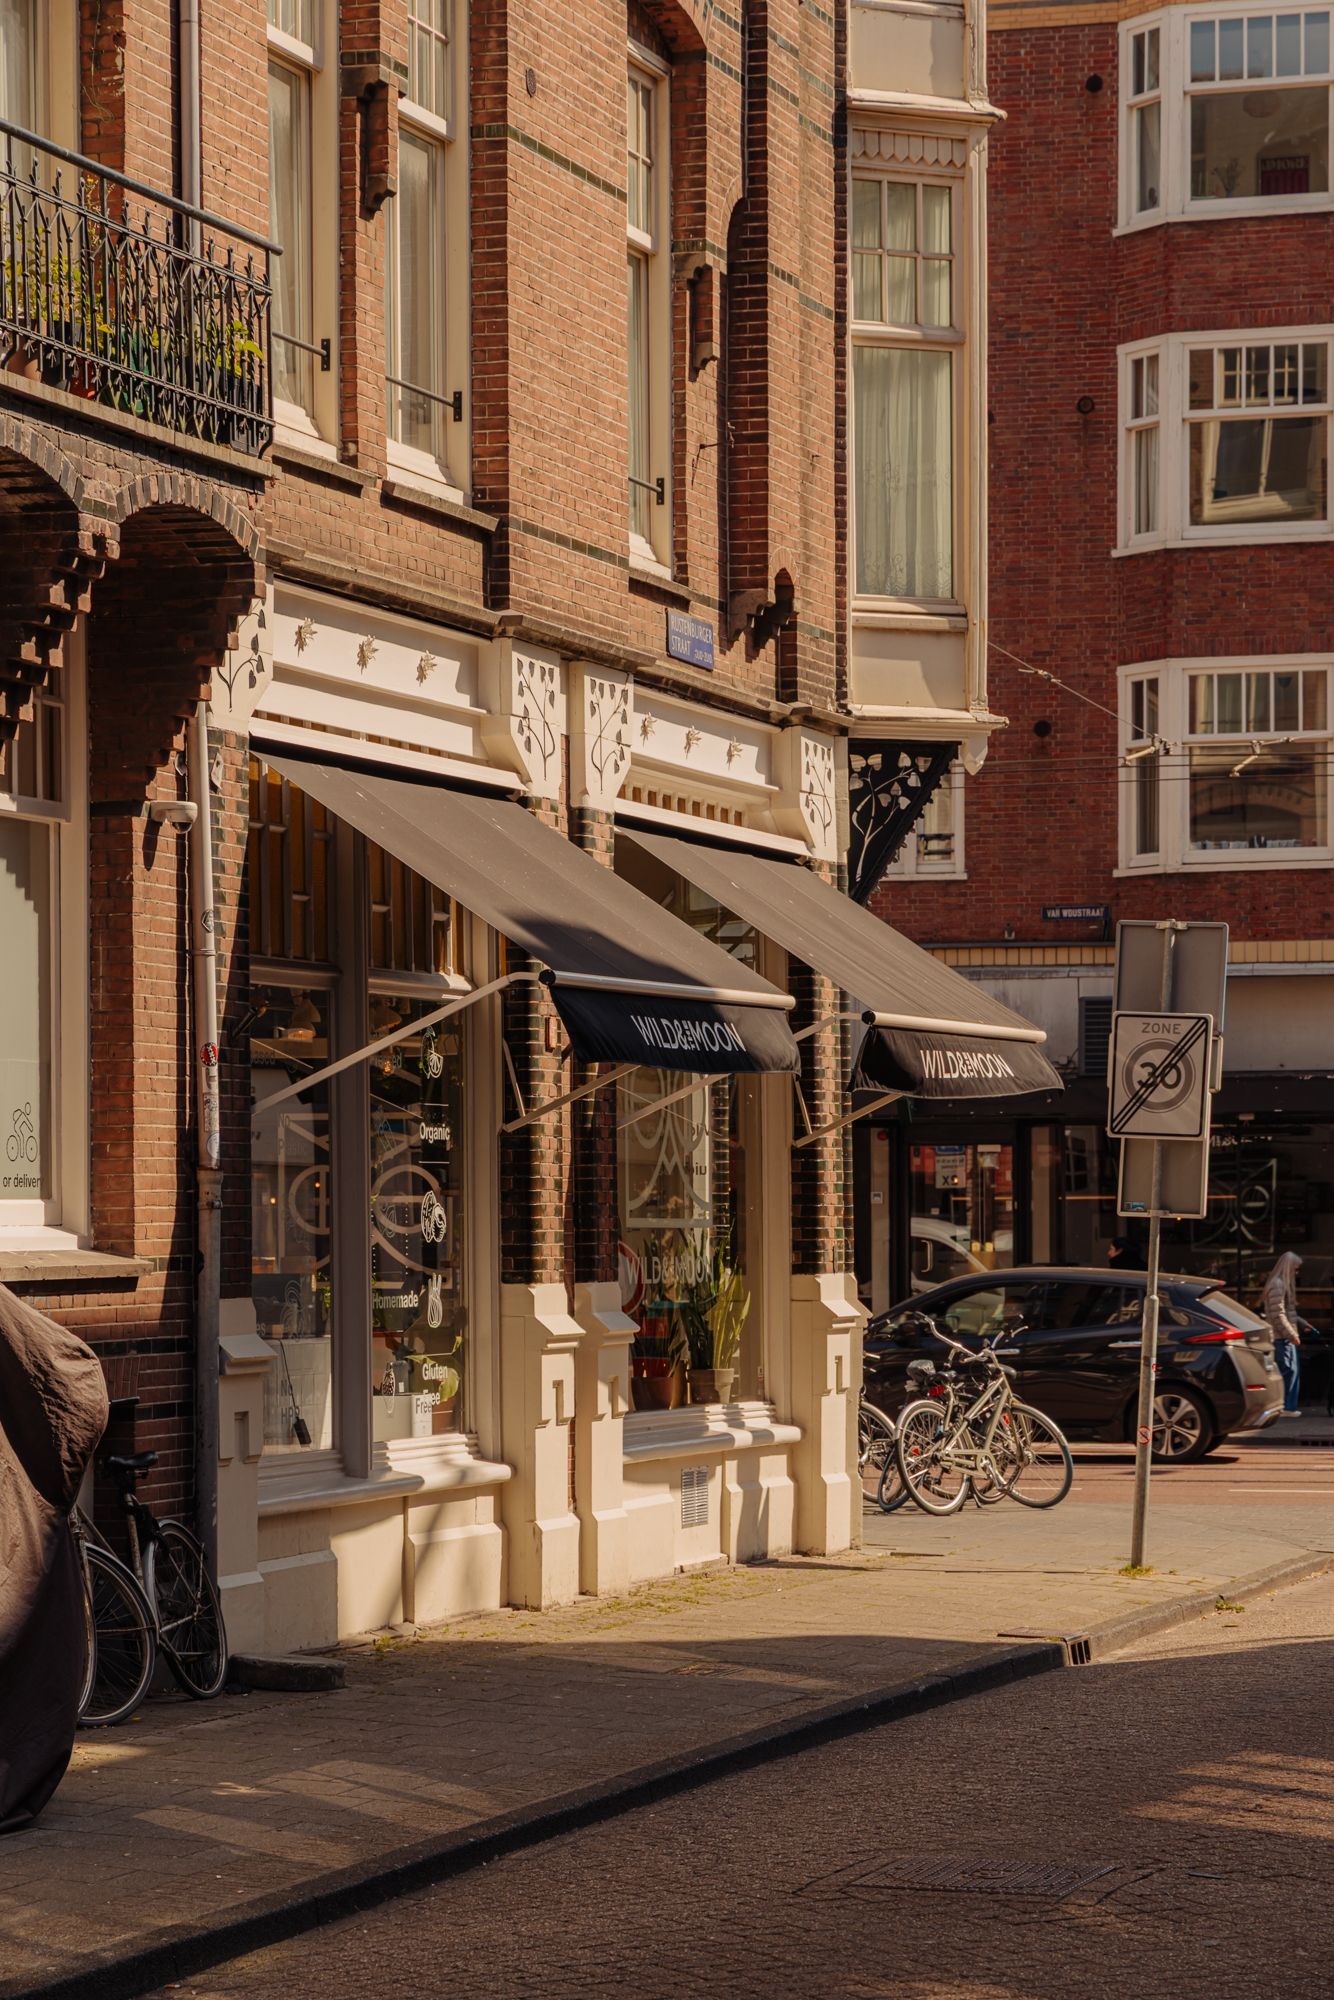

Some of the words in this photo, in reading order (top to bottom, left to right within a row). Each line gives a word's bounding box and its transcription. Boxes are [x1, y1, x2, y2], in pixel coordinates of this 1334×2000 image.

[671, 635, 691, 656] STRAAT
[1046, 908, 1061, 918] VAN
[1141, 1022, 1182, 1034] ZONE
[1137, 1062, 1182, 1090] 30
[419, 1122, 450, 1144] Organic
[2, 1176, 12, 1188] or
[372, 1290, 419, 1309] Homemade
[422, 1363, 448, 1381] Gluten
